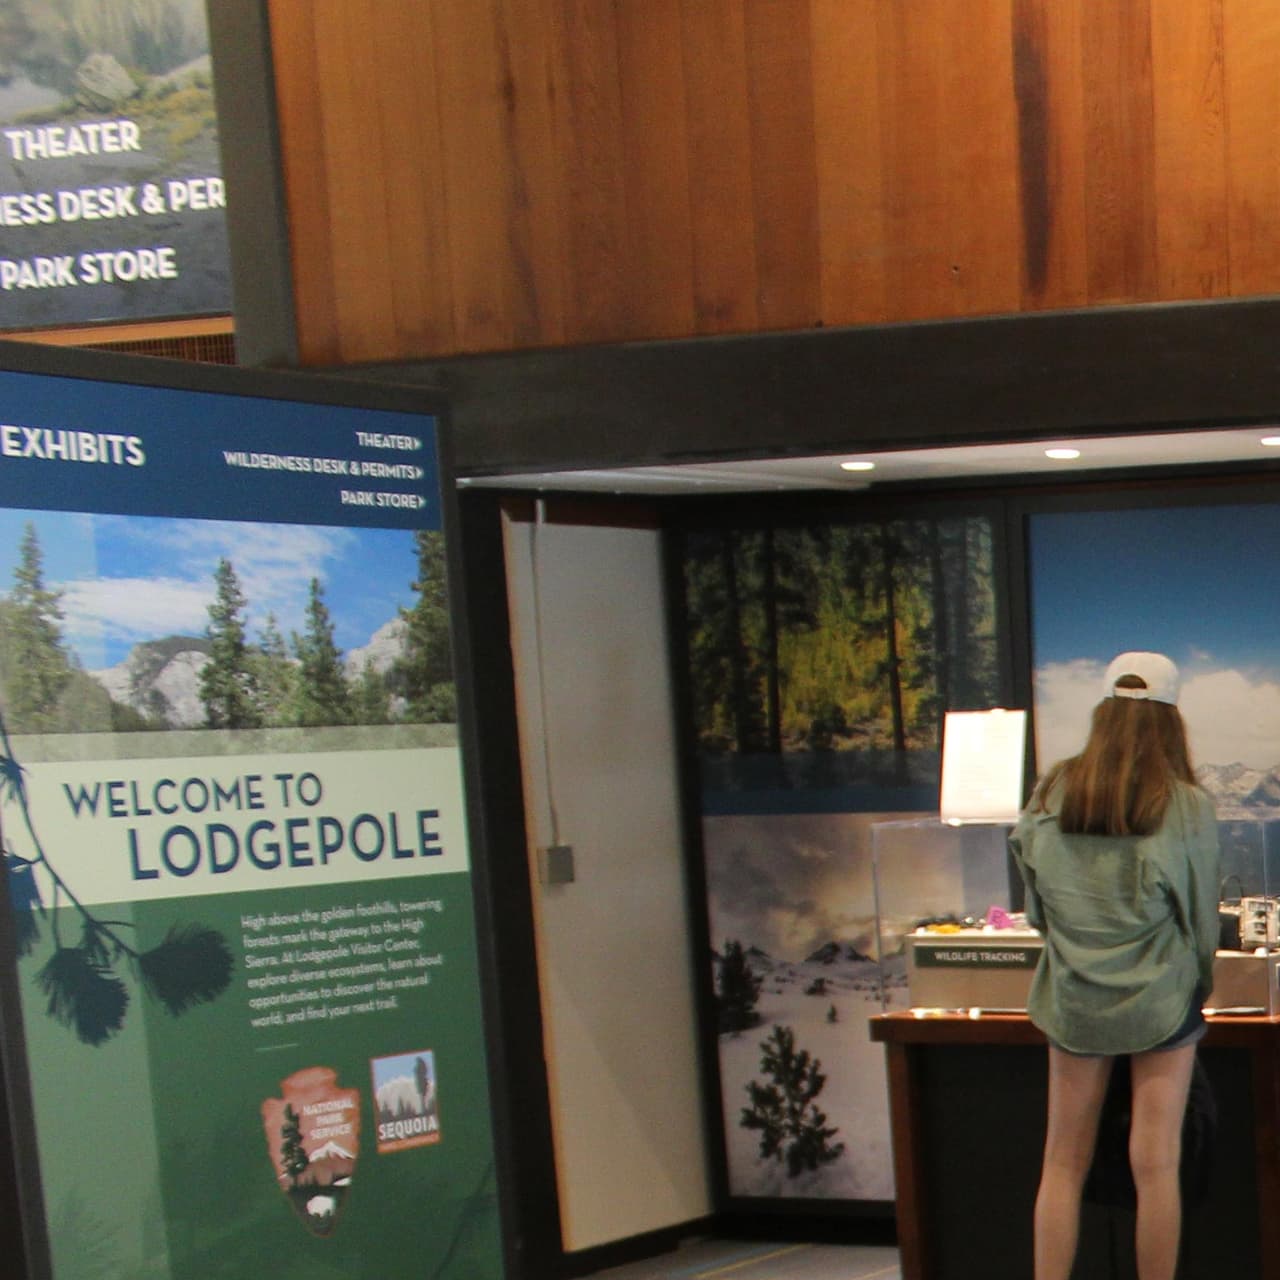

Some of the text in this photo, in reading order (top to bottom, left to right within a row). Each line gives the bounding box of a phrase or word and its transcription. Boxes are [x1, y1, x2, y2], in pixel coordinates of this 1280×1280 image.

[4, 120, 142, 160] THEATER
[57, 186, 139, 222] DESK
[141, 183, 167, 215] &
[0, 247, 179, 290] PARK STORE
[1, 425, 146, 467] EXHIBITS
[355, 431, 412, 450] THEATER
[223, 451, 415, 479] WILDERNESS DESK & PERMITS
[340, 490, 416, 508] PARK STORE
[62, 773, 323, 818] WELCOME TO
[128, 809, 443, 880] LODGEPOLE
[934, 951, 1025, 962] WILDLIFE TRACKING
[303, 1098, 354, 1115] NATIONAL
[310, 1122, 353, 1140] SERVICE
[378, 1114, 438, 1140] SEQUOIA
